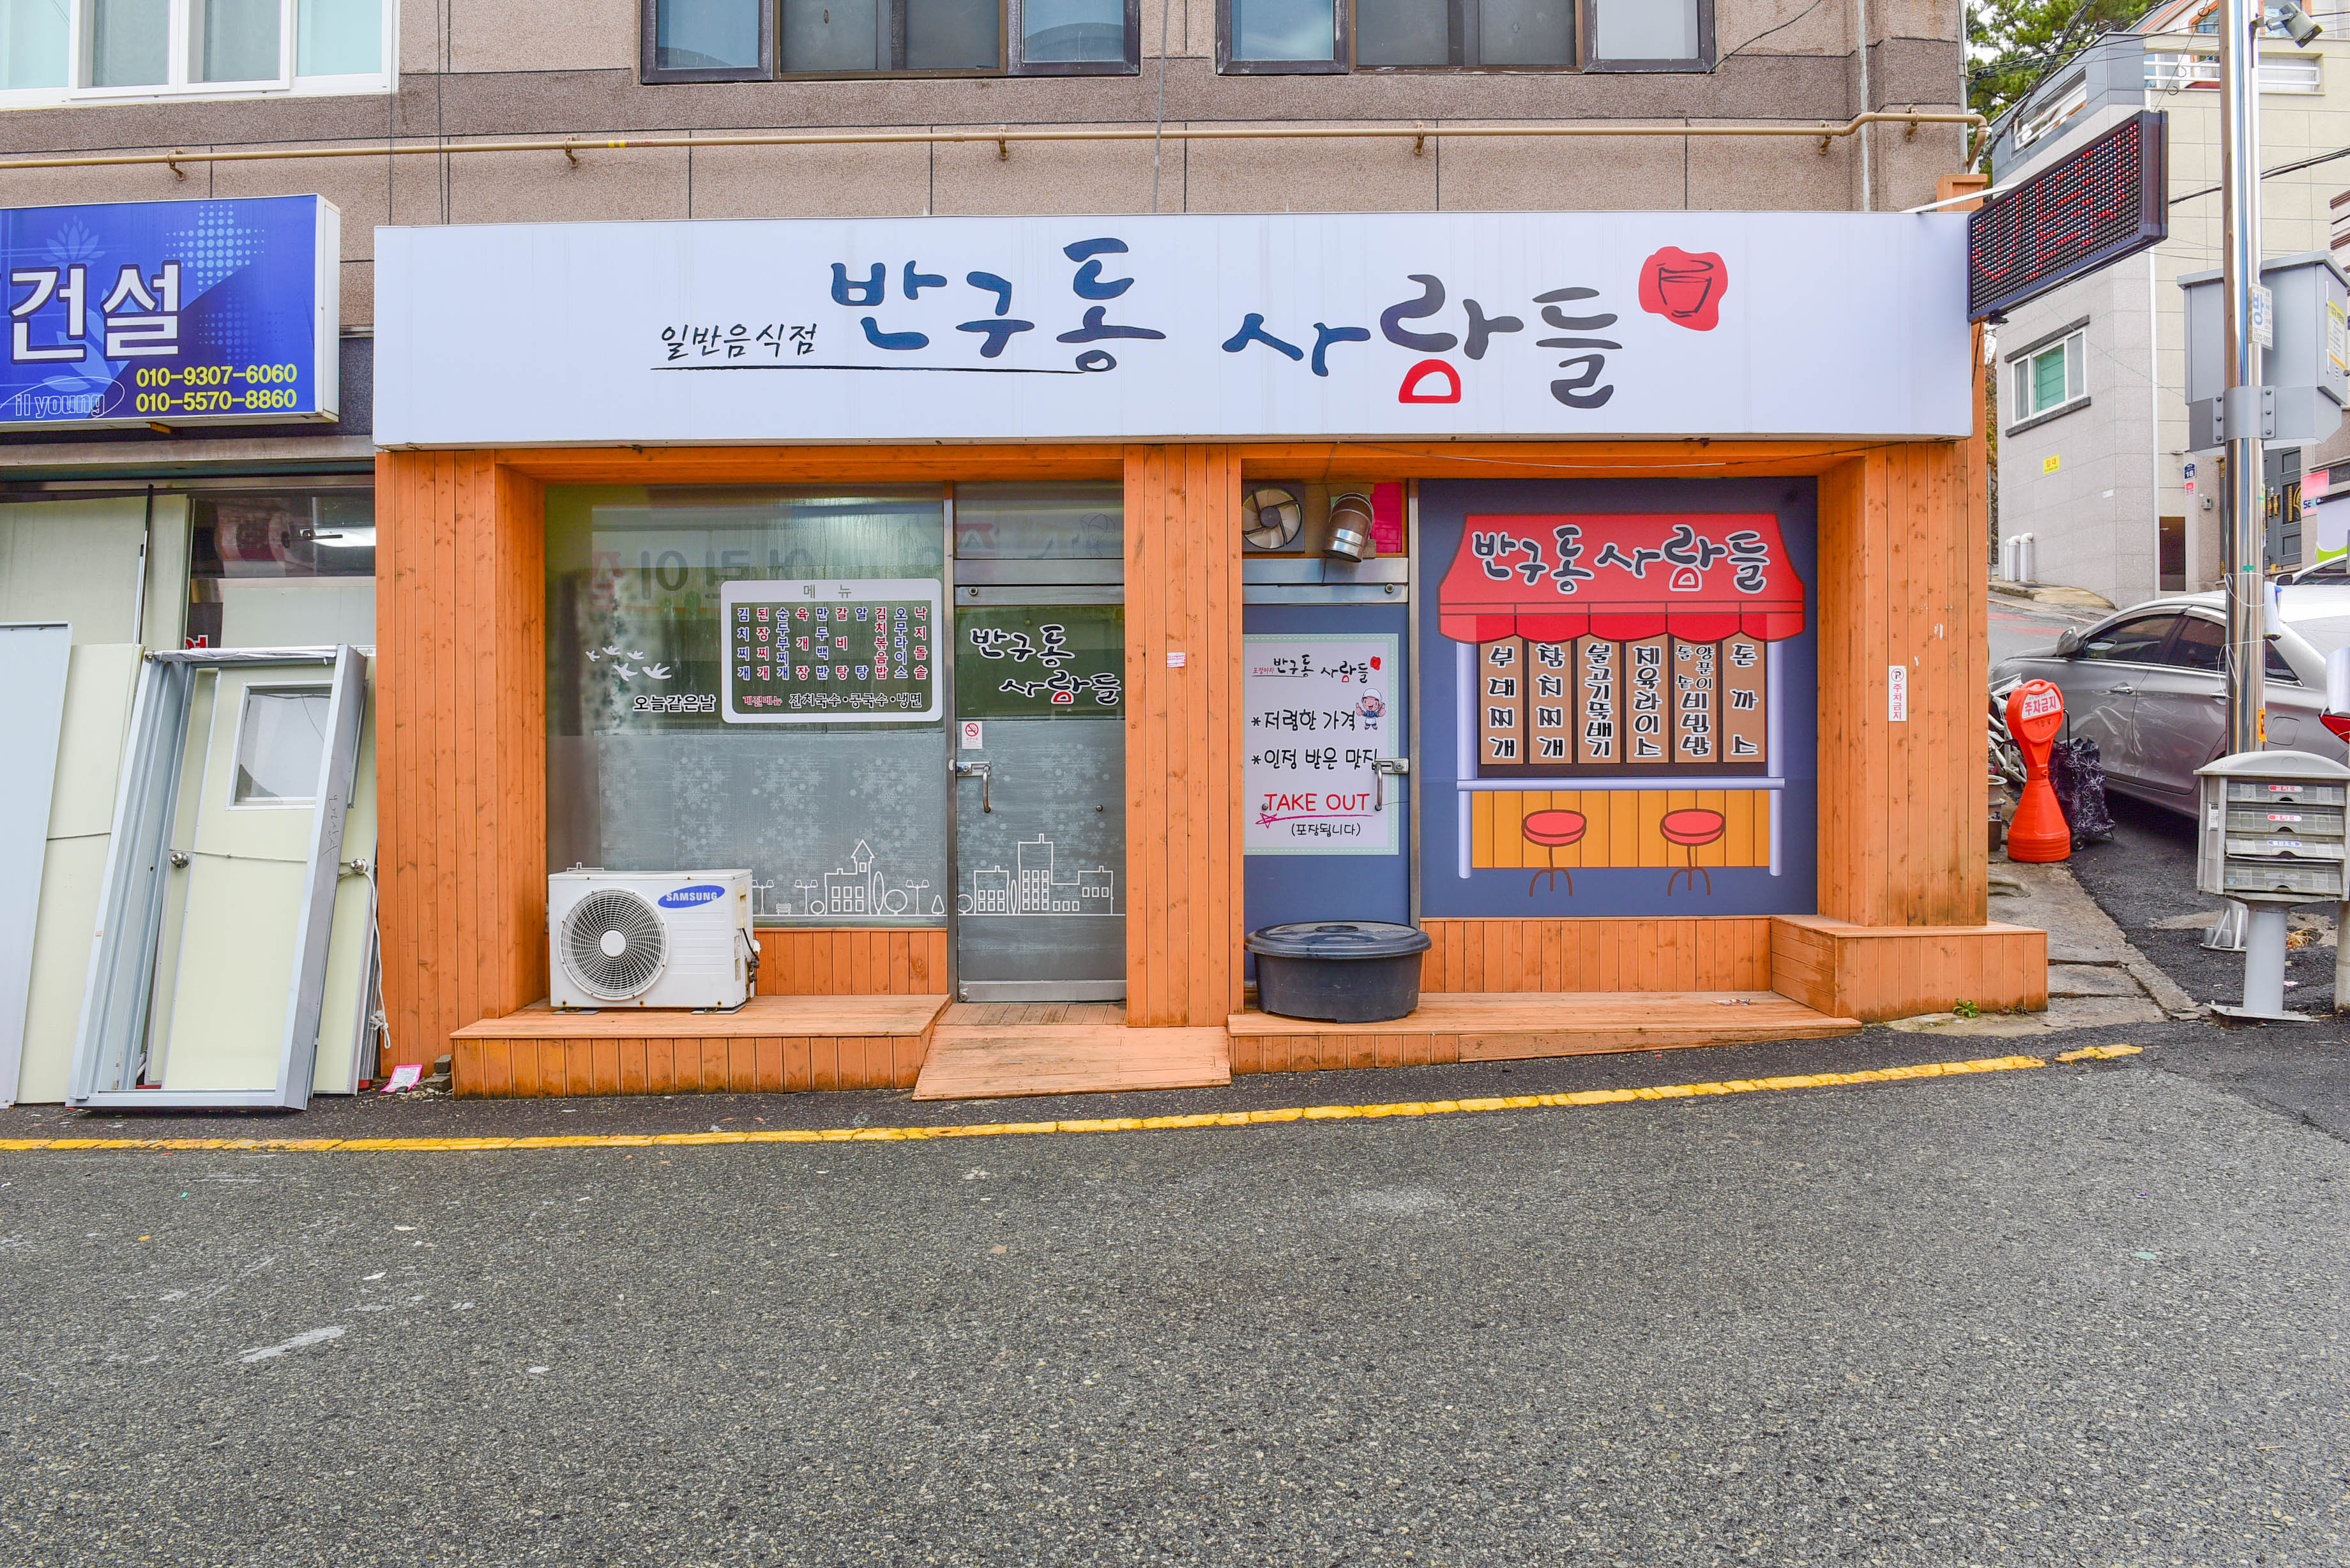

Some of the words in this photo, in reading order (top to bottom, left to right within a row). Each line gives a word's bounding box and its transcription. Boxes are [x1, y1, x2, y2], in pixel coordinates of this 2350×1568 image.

[9, 260, 182, 364] 건설
[660, 322, 818, 361] 일반음식점
[831, 237, 1166, 372] 반구동
[1222, 274, 1623, 409] 사람들
[35, 392, 105, 419] young
[136, 363, 298, 388] 010-9307-6060
[136, 389, 298, 412] 010-5570-8860
[737, 607, 750, 681] 김치찌개
[757, 607, 769, 681] 된장찌개
[776, 607, 789, 681] 순두부찌개
[796, 607, 809, 681] 육개장
[815, 607, 829, 681] 만두백반
[835, 607, 849, 681] 갈비탕
[874, 607, 888, 681] 김치볶음밥
[894, 607, 907, 681] 오무라이스
[914, 607, 928, 681] 낙지돌솥
[970, 624, 1075, 668] 반구동
[1252, 667, 1275, 675] 포장마차
[1273, 654, 1314, 677] 반구동
[1321, 661, 1368, 683] 사람들
[742, 695, 782, 706] 계절메뉴
[998, 670, 1122, 705] 사람들
[1264, 708, 1317, 731] 저렴한
[1323, 709, 1356, 731] 가격
[1488, 646, 1516, 758] 부대찌개
[1536, 643, 1566, 758] 참치찌개
[1585, 643, 1614, 757] 불고기뚝배기
[1633, 645, 1662, 758] 제육라이스
[1680, 691, 1712, 757] 비빔밥
[1730, 642, 1759, 755] 돈까스
[1892, 684, 1902, 720] 주차금지
[2025, 695, 2056, 716] 주차금지
[1264, 748, 1297, 770] 인정
[1264, 794, 1317, 812] TAKE
[1326, 794, 1370, 811] OUT
[666, 891, 718, 902] SAMSUNG
